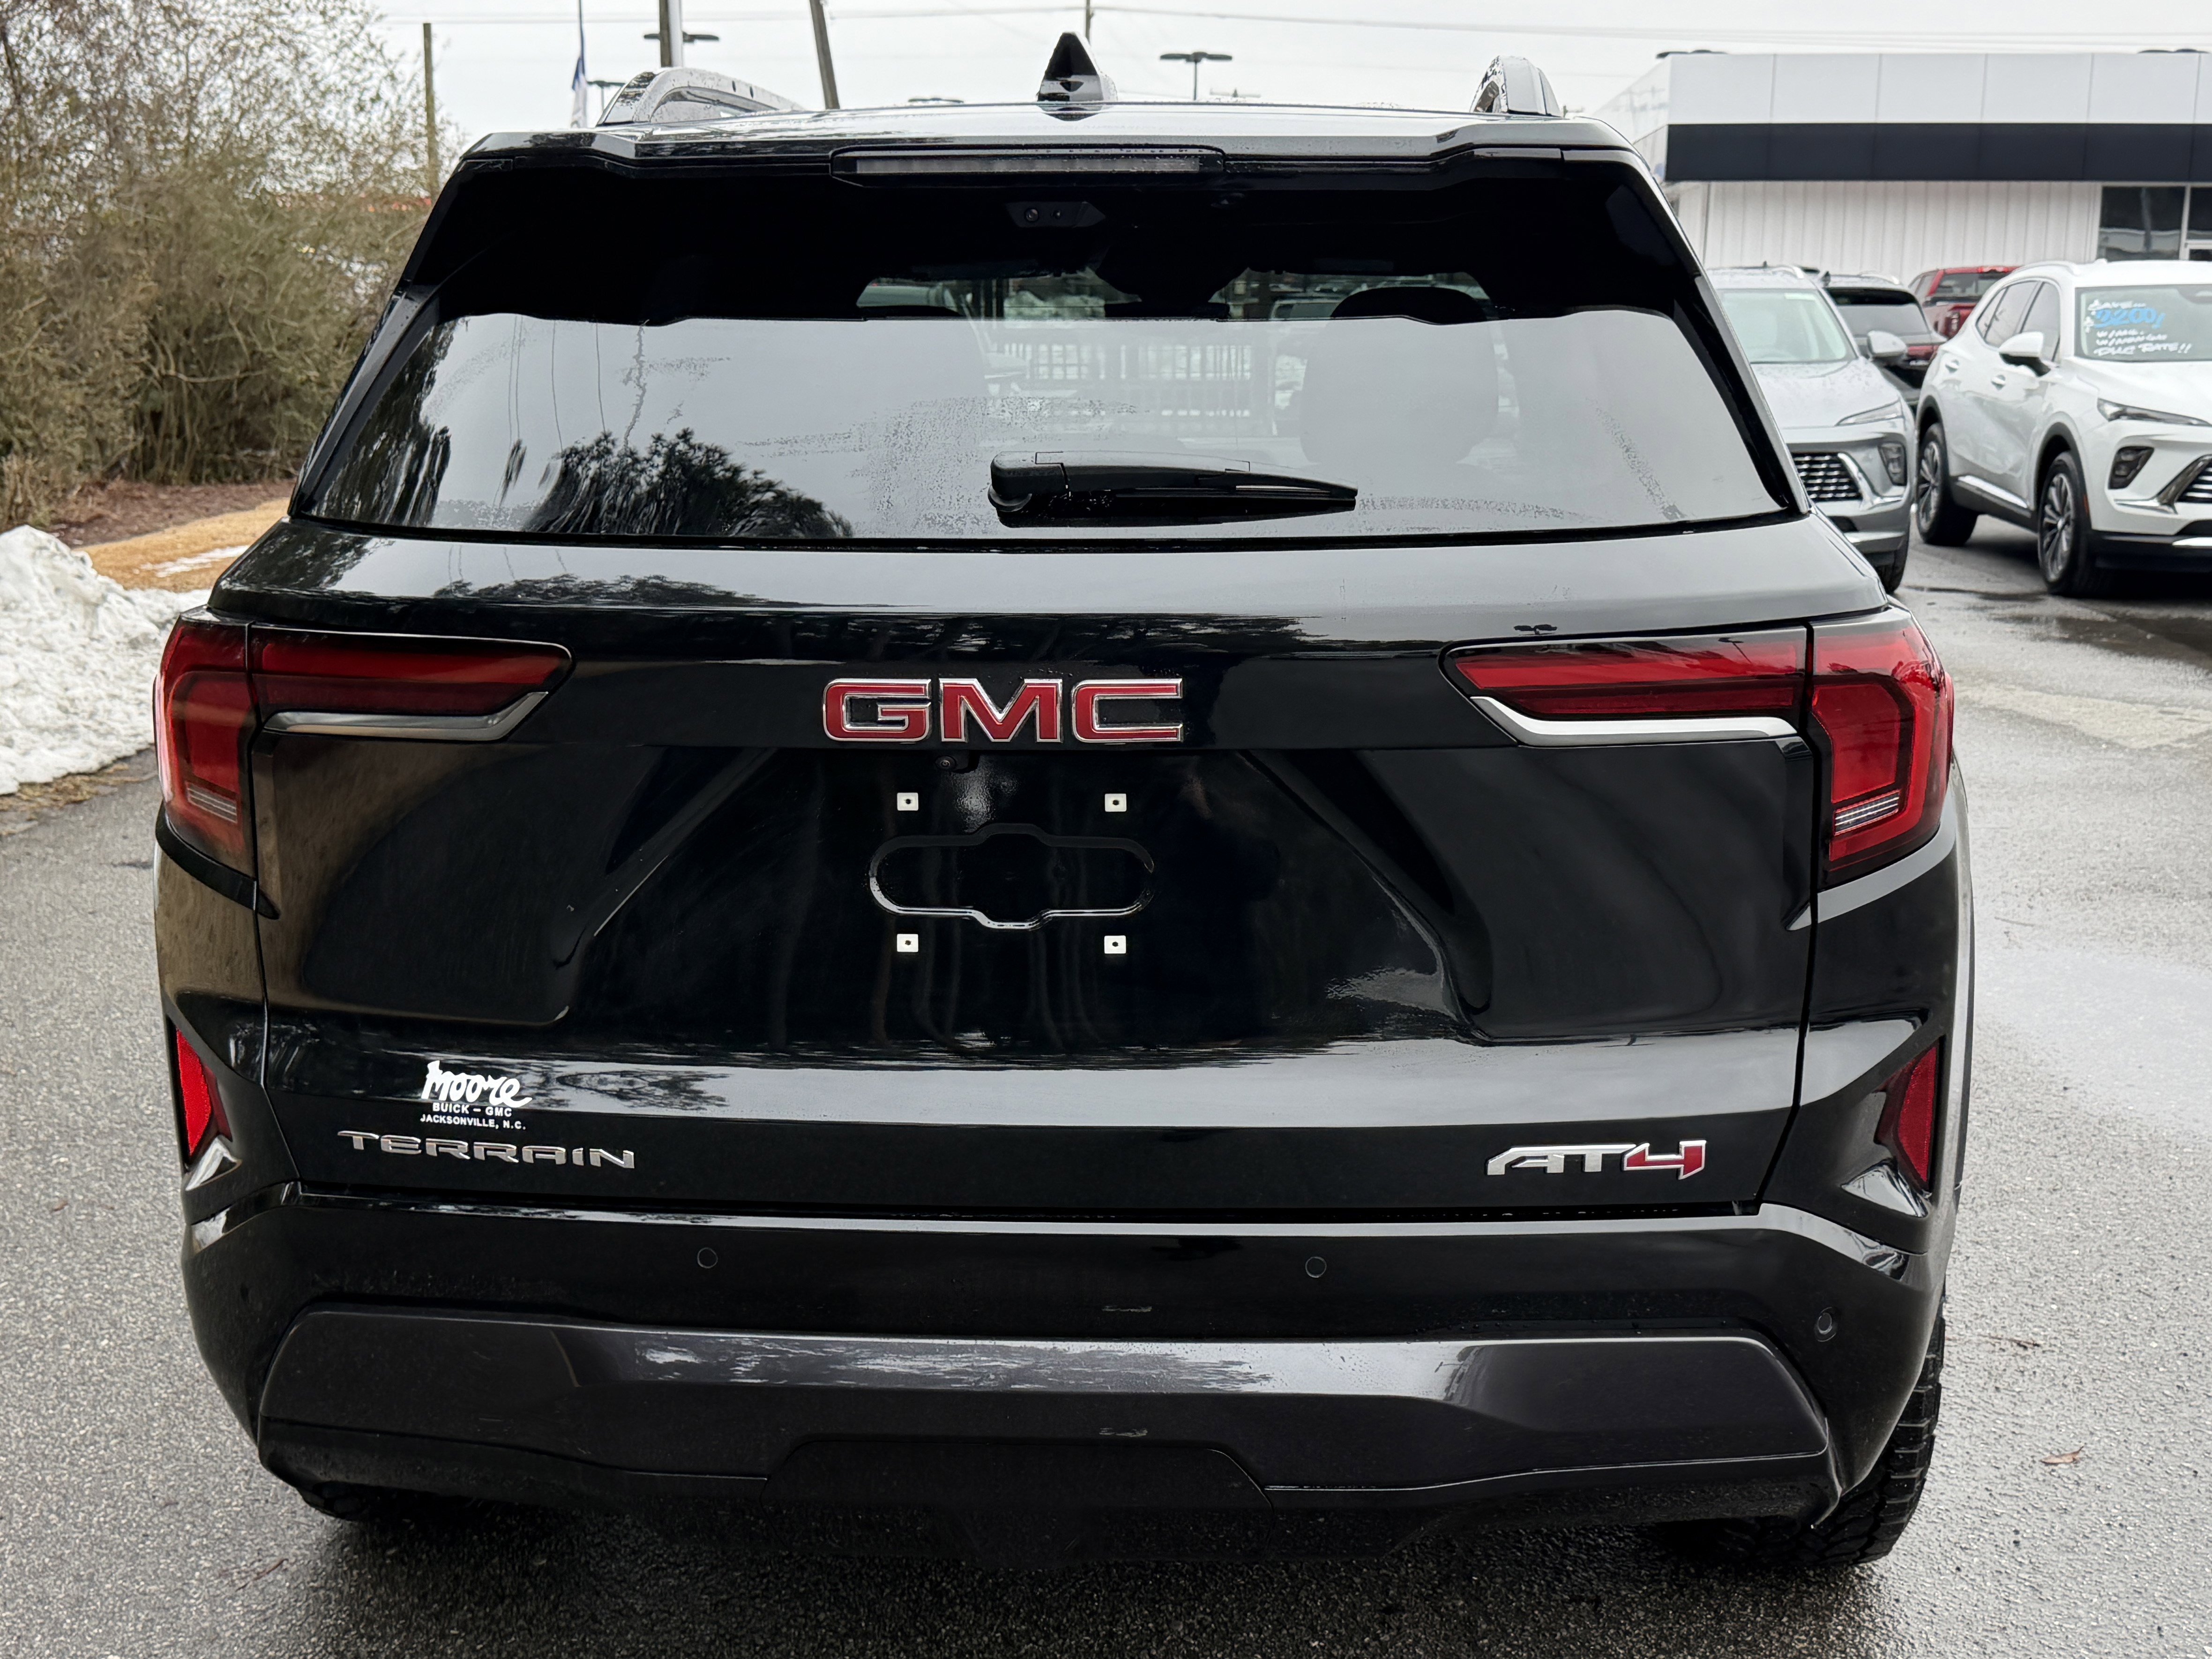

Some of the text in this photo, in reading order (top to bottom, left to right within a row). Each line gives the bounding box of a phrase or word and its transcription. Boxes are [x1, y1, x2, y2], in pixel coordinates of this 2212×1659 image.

[822, 678, 1183, 743] GMC
[420, 1114, 526, 1130] JACKSONVILLE, N.C.
[432, 1102, 470, 1114] BUICK
[485, 1106, 513, 1117] GMC
[337, 1130, 635, 1169] TERRAIN
[1486, 1140, 1707, 1180] AT4
